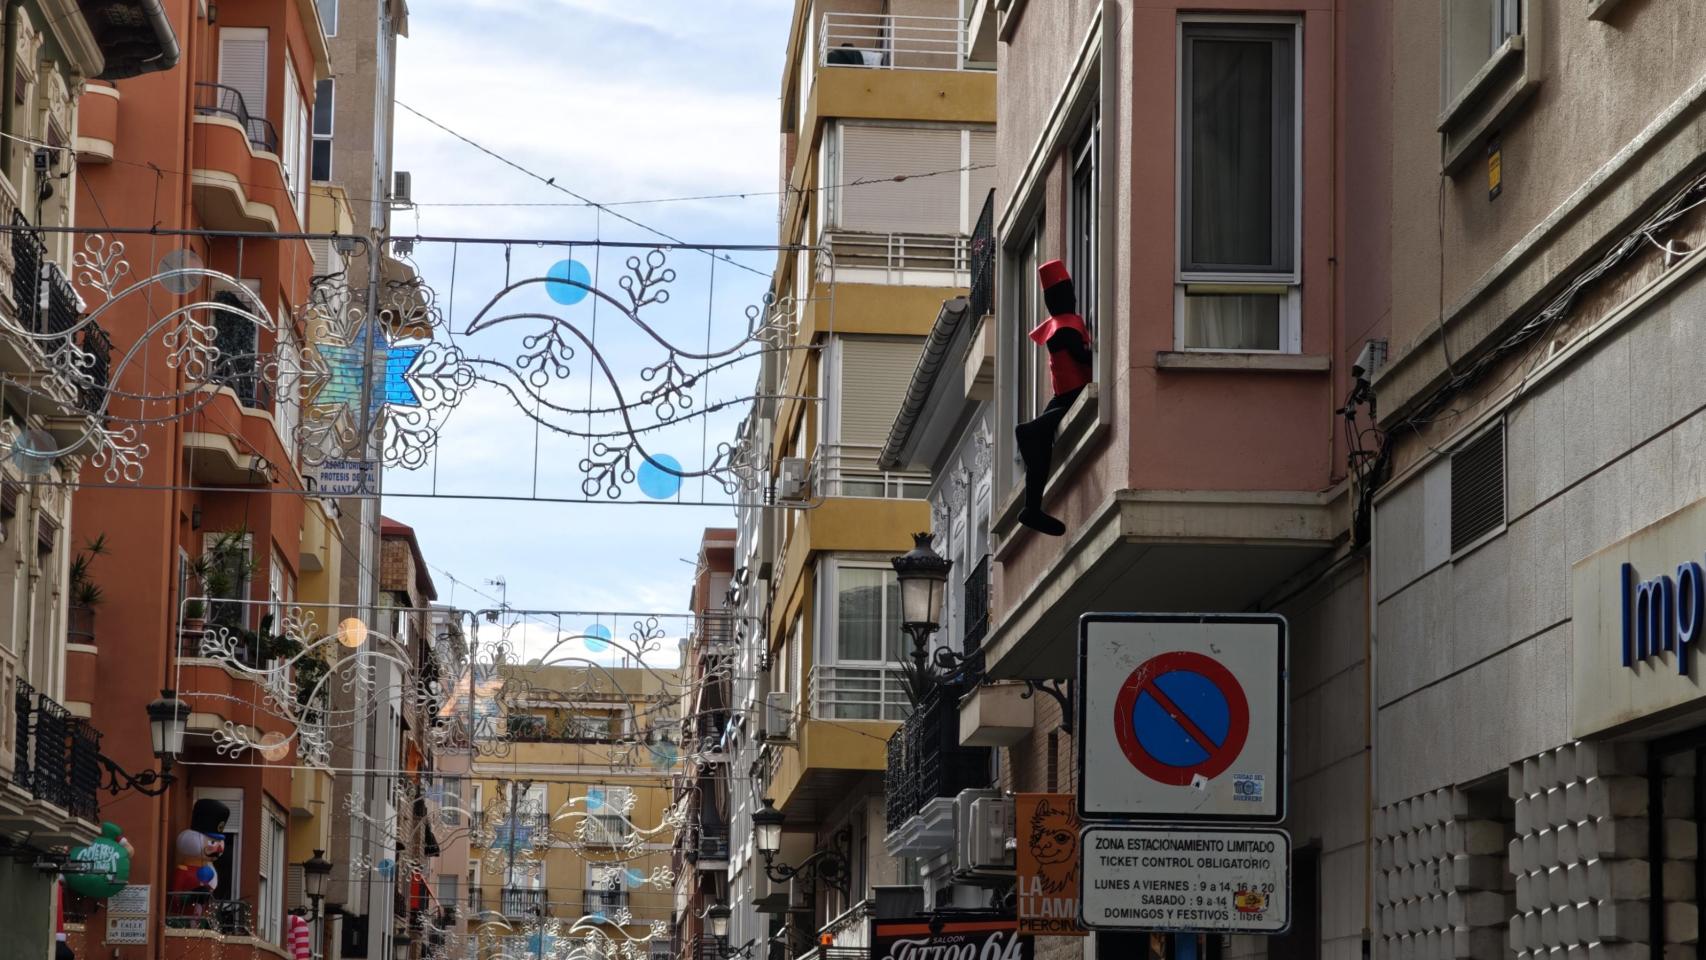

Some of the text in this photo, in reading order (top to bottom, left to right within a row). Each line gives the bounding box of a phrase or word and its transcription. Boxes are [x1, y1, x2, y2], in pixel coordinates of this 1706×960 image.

[320, 472, 375, 482] PROTESIS DETAL
[1621, 561, 1706, 676] Imp
[1095, 837, 1275, 853] ZONA ESTACIONAMIENTO LIMITADO
[1100, 856, 1271, 870] TICKET CONTROL OBLIGATORIO
[1019, 876, 1043, 897] LA
[1094, 879, 1130, 891] LUNES
[1134, 880, 1141, 891] A
[1141, 880, 1190, 891] VIERNES
[1200, 881, 1207, 892] 9
[1210, 883, 1217, 892] a
[1237, 882, 1248, 892] 16
[1252, 884, 1258, 893] a
[1261, 883, 1275, 894] 20
[1141, 895, 1186, 906] SABADO
[1196, 896, 1203, 906] 9
[1206, 898, 1213, 906] a
[1216, 896, 1227, 906] 14
[1104, 908, 1164, 919] DOMINGOS
[1166, 908, 1173, 919] Y
[1177, 908, 1229, 920] FESTIVOS
[1239, 911, 1263, 921] libre
[1020, 919, 1078, 931] PIERCIN
[881, 931, 1023, 960] TATTOO 64
[932, 935, 965, 944] SALOON
